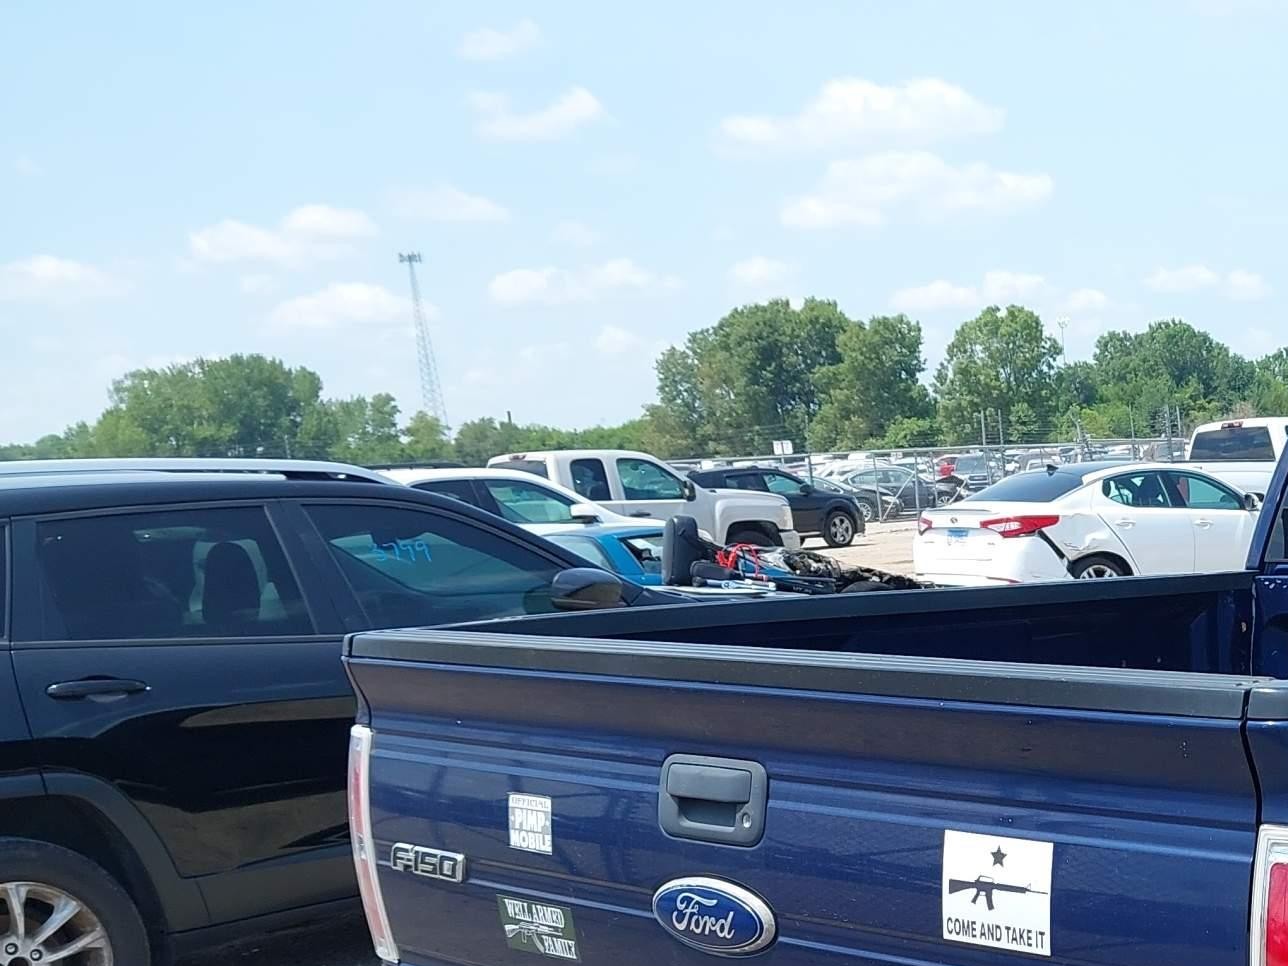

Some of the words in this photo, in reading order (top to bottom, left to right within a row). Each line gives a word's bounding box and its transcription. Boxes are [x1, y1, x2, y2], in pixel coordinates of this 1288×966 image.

[514, 808, 546, 833] PIMP
[509, 829, 553, 853] MOBILE
[503, 898, 532, 921] WELL
[532, 904, 565, 929] ARMED
[672, 892, 735, 939] Ford
[946, 916, 977, 938] COME
[980, 921, 1003, 942] AND
[1004, 925, 1033, 947] TAKE
[1035, 929, 1046, 949] IT
[542, 935, 578, 960] FAMILY
